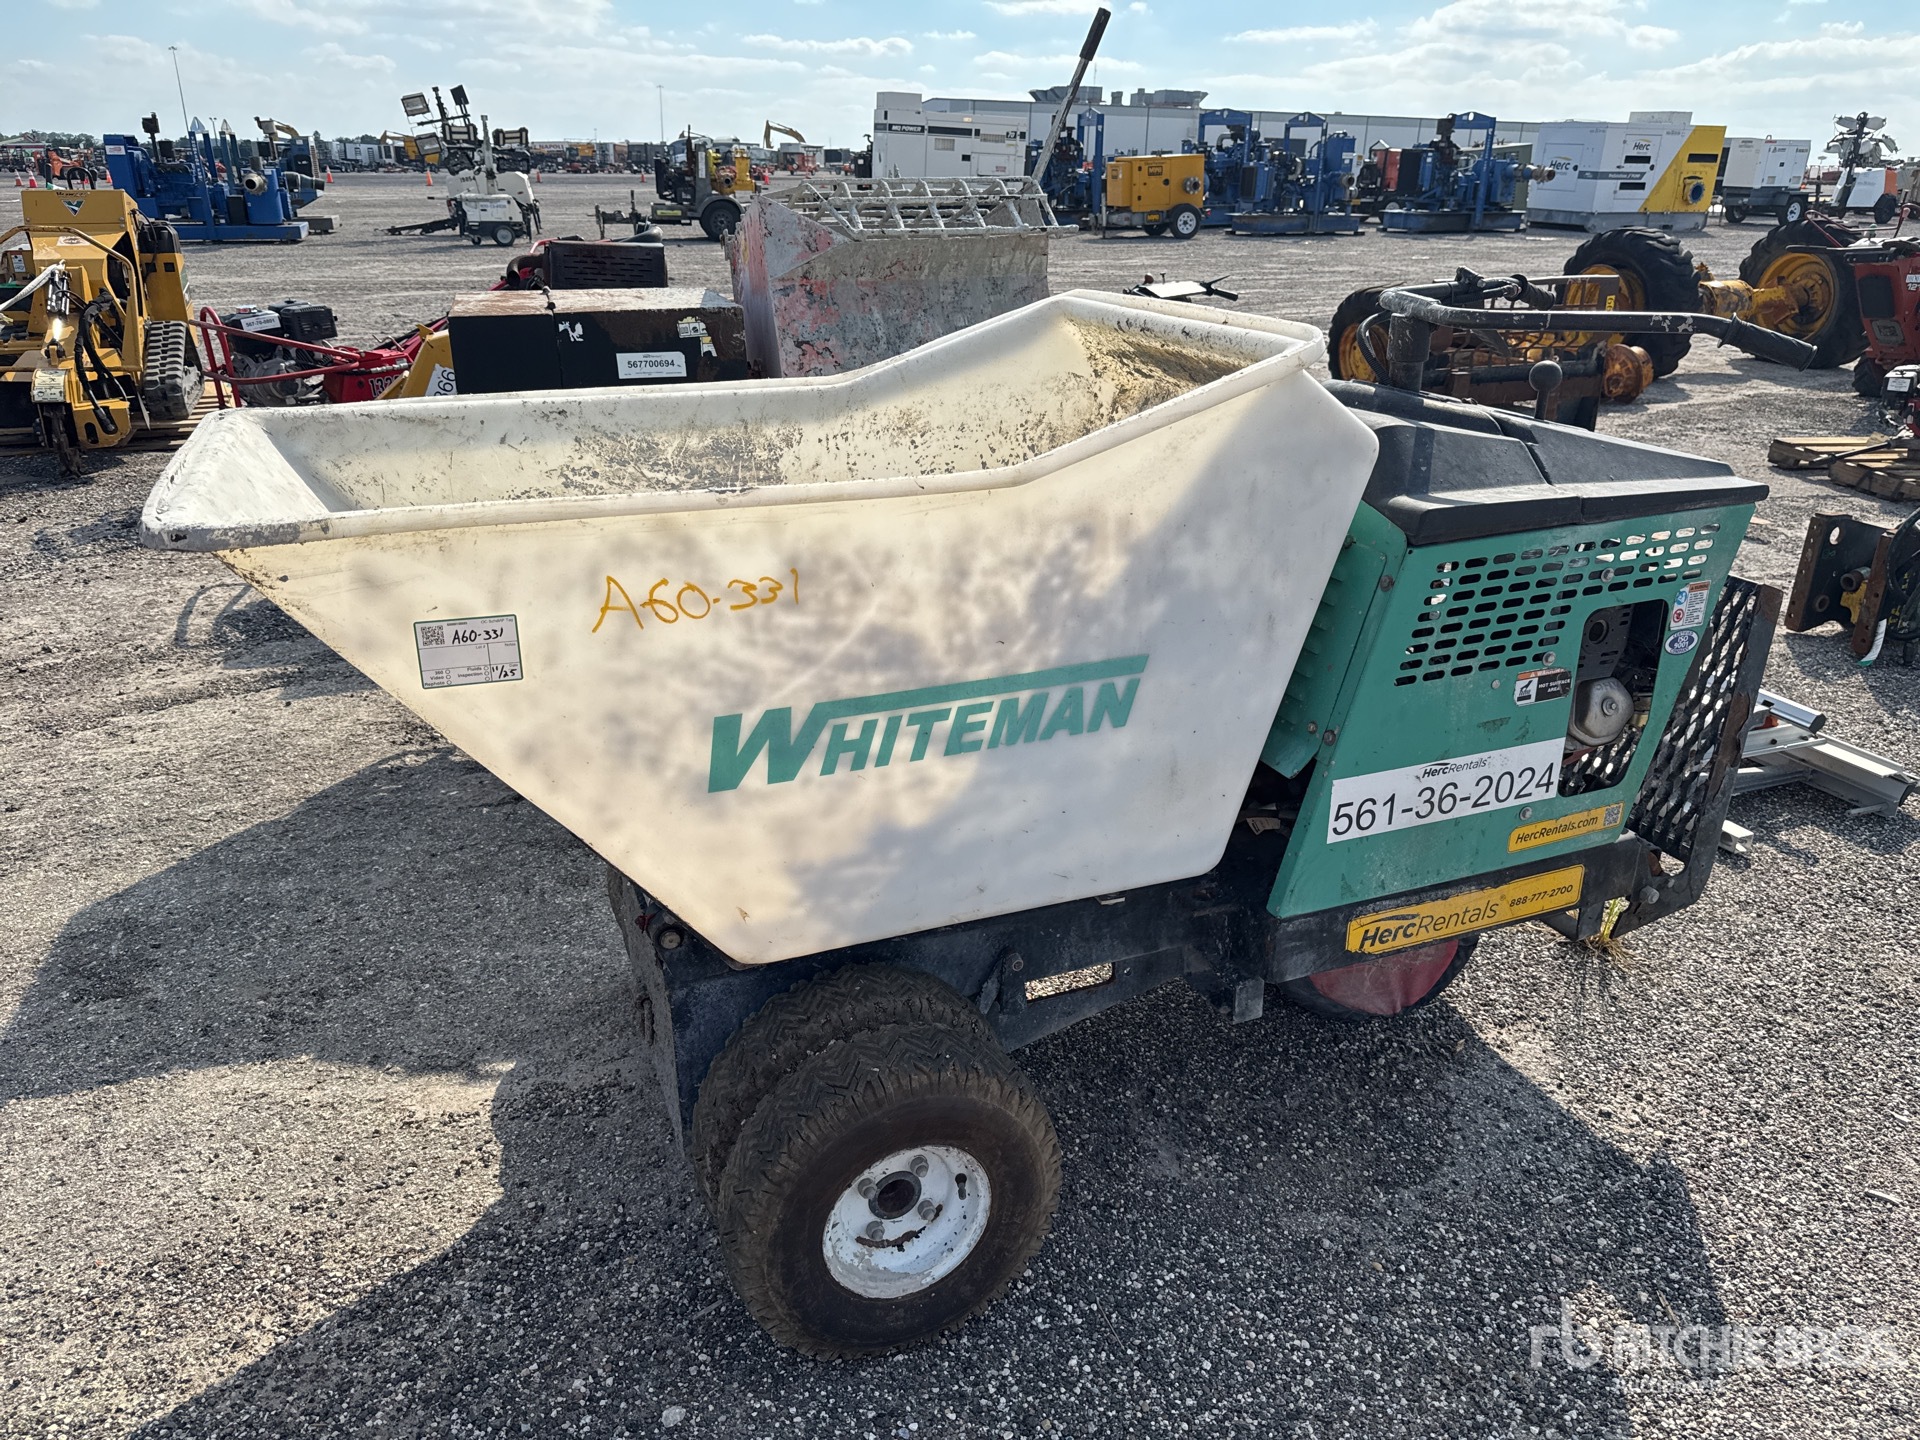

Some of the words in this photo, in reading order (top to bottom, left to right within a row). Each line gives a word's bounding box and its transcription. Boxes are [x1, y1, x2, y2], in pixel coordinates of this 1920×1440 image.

[901, 125, 922, 133] POWER
[1633, 141, 1651, 151] Herc
[1550, 159, 1570, 171] Herc
[627, 359, 675, 369] 567700694
[708, 654, 1149, 793] WHITEMAN
[1332, 762, 1554, 836] 561-36-2024
[1515, 815, 1598, 844] HercRentals.com
[1509, 884, 1574, 908] 888-777-2700
